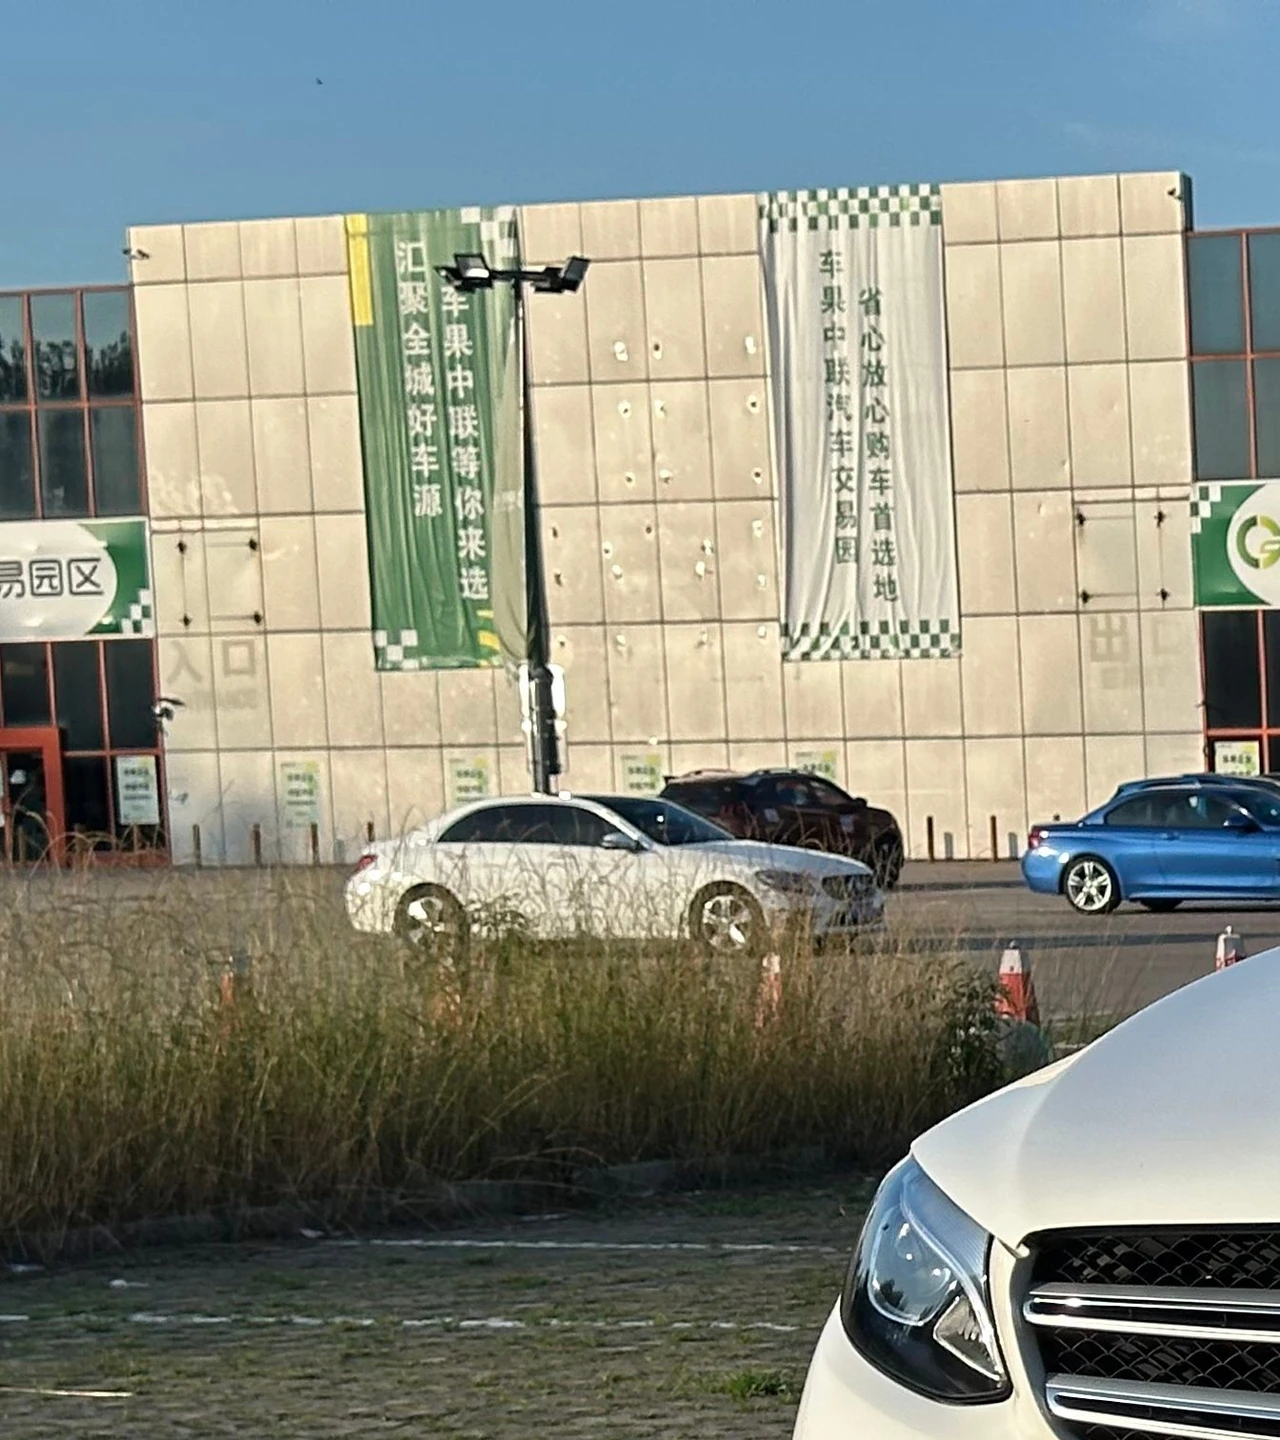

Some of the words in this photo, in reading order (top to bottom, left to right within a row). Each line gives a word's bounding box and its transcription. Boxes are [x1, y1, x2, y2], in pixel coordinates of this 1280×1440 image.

[397, 240, 442, 518] 汇聚全城好车源
[440, 285, 489, 600] 车果中联等你来选
[818, 249, 858, 565] 车果中联汽车交易园
[859, 287, 899, 602] 省心放心购车首选地
